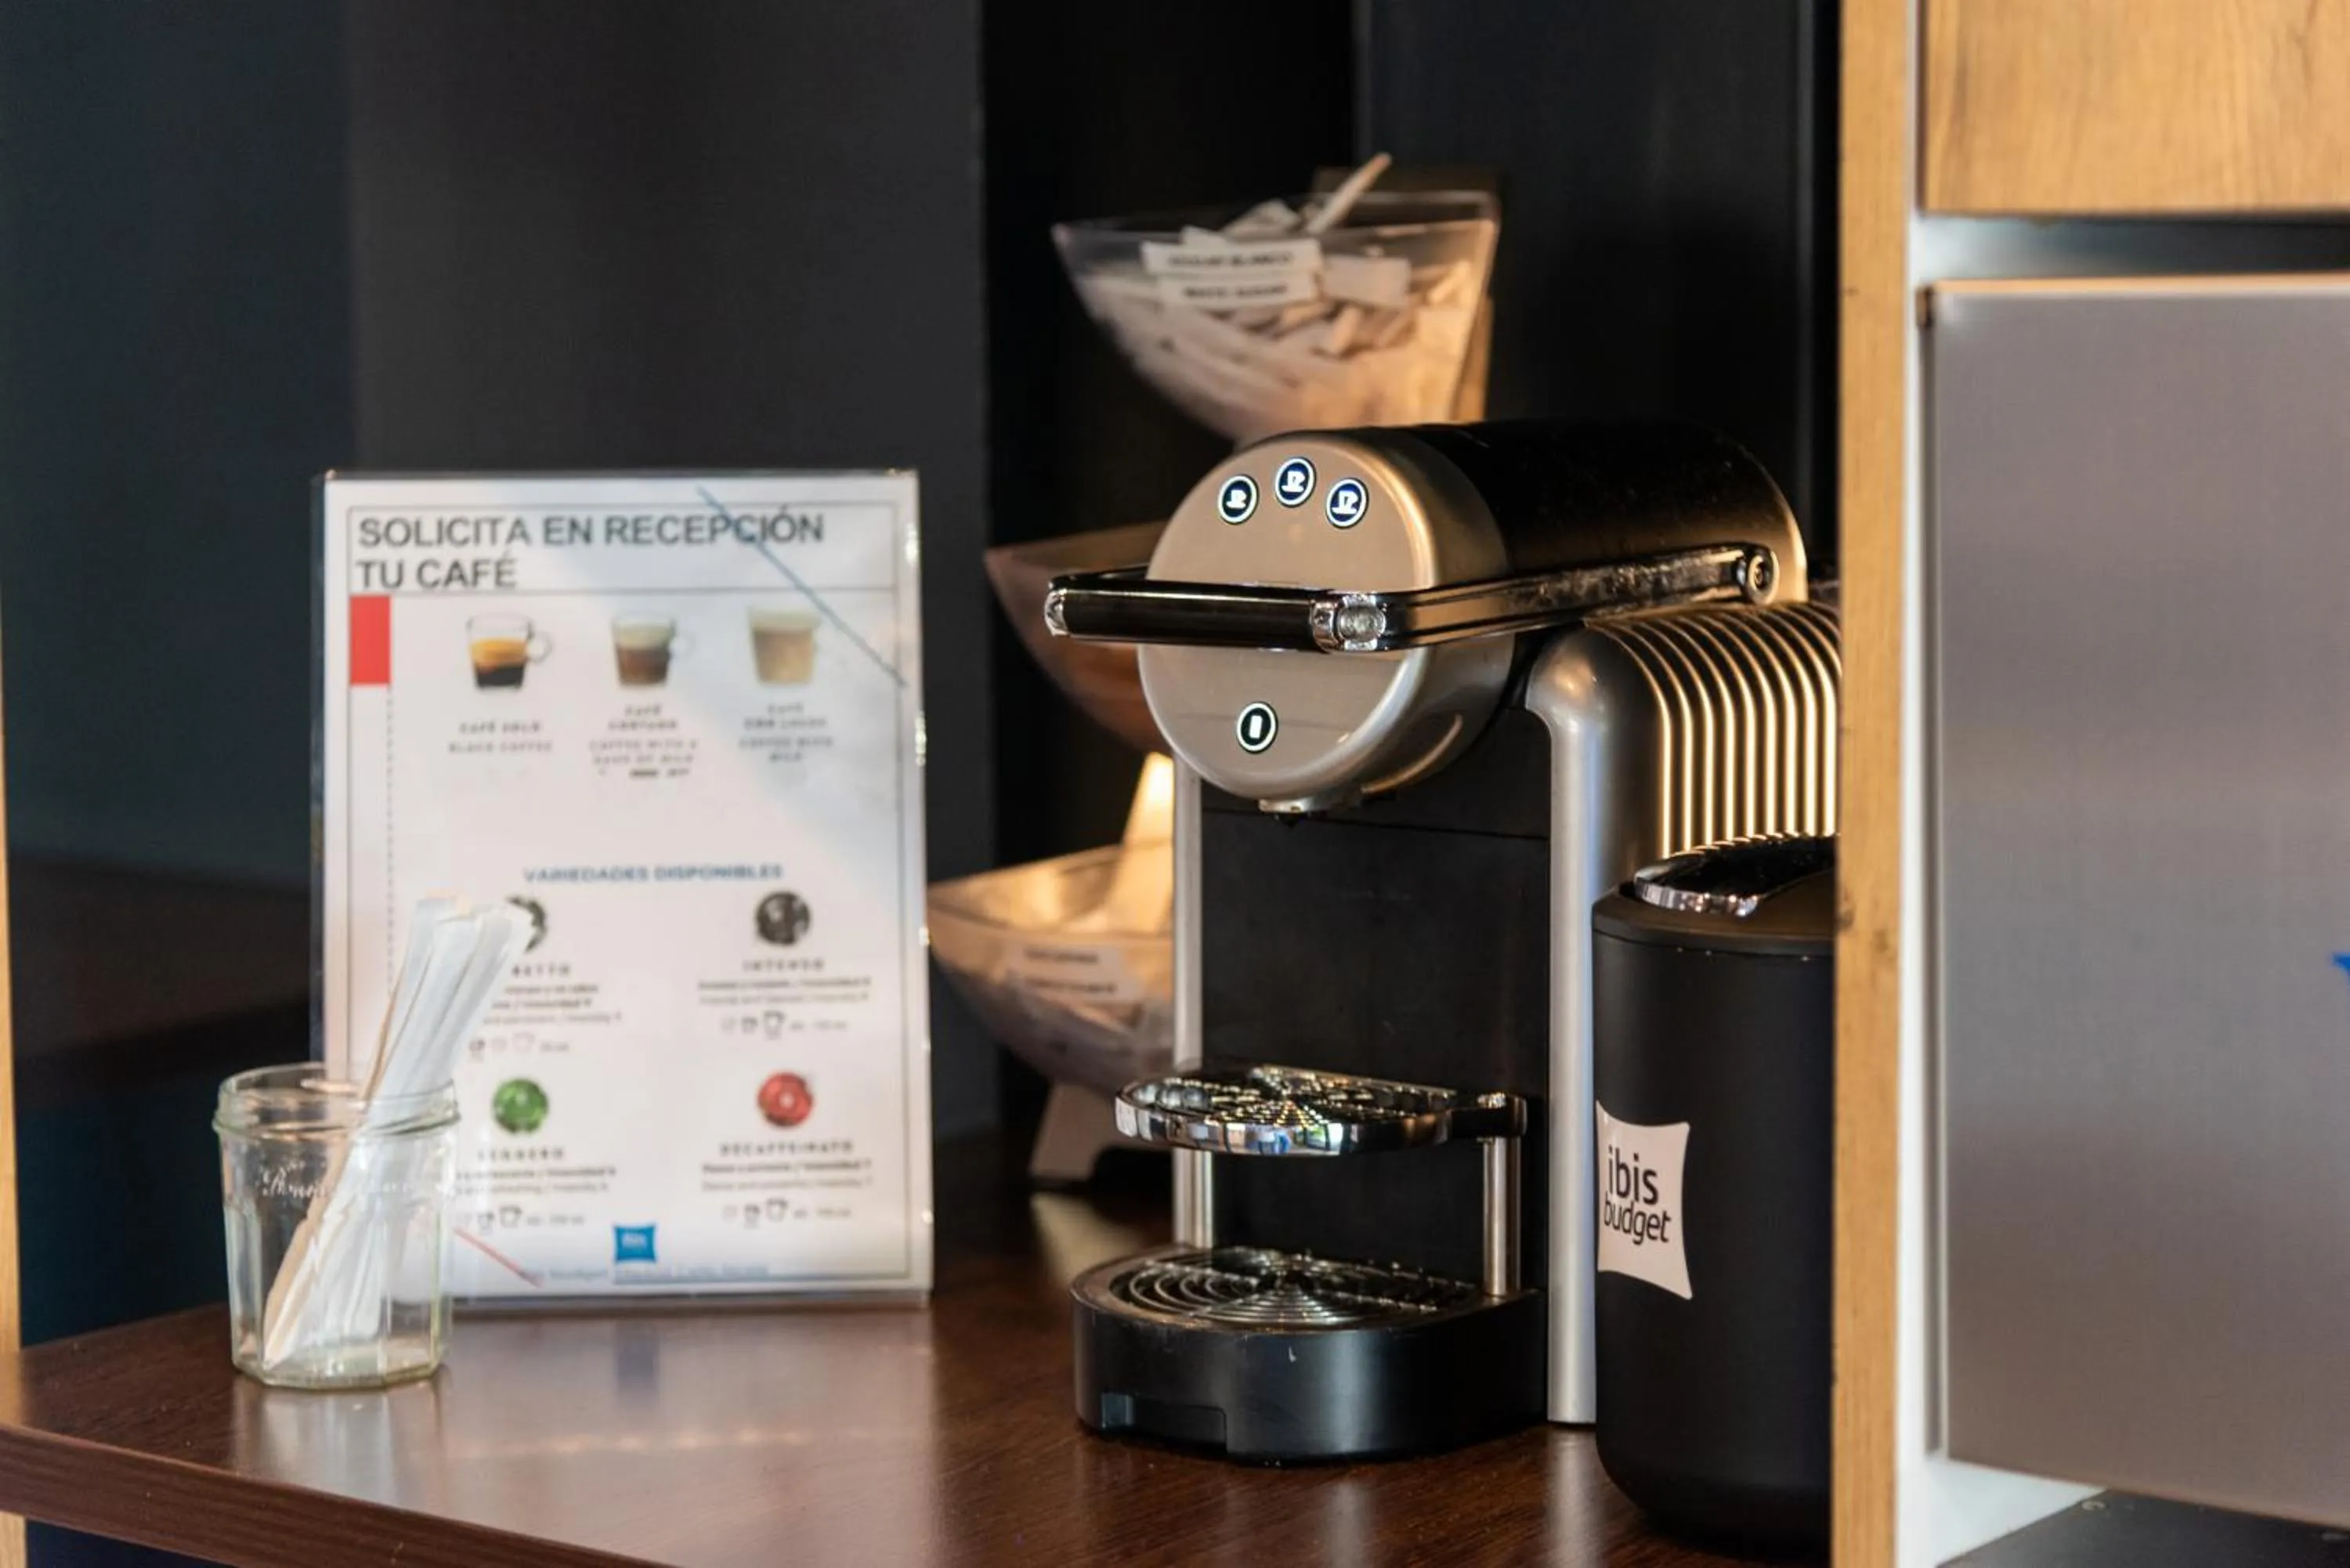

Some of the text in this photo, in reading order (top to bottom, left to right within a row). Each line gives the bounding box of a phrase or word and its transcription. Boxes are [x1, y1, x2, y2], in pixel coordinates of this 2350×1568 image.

[359, 504, 824, 547] SOLICITA EN RECEPCIÓN
[356, 549, 518, 589] TU CAFÉ
[523, 865, 649, 883] VARIEDADES
[1608, 1144, 1658, 1205] ibis
[1604, 1190, 1672, 1245] budget
